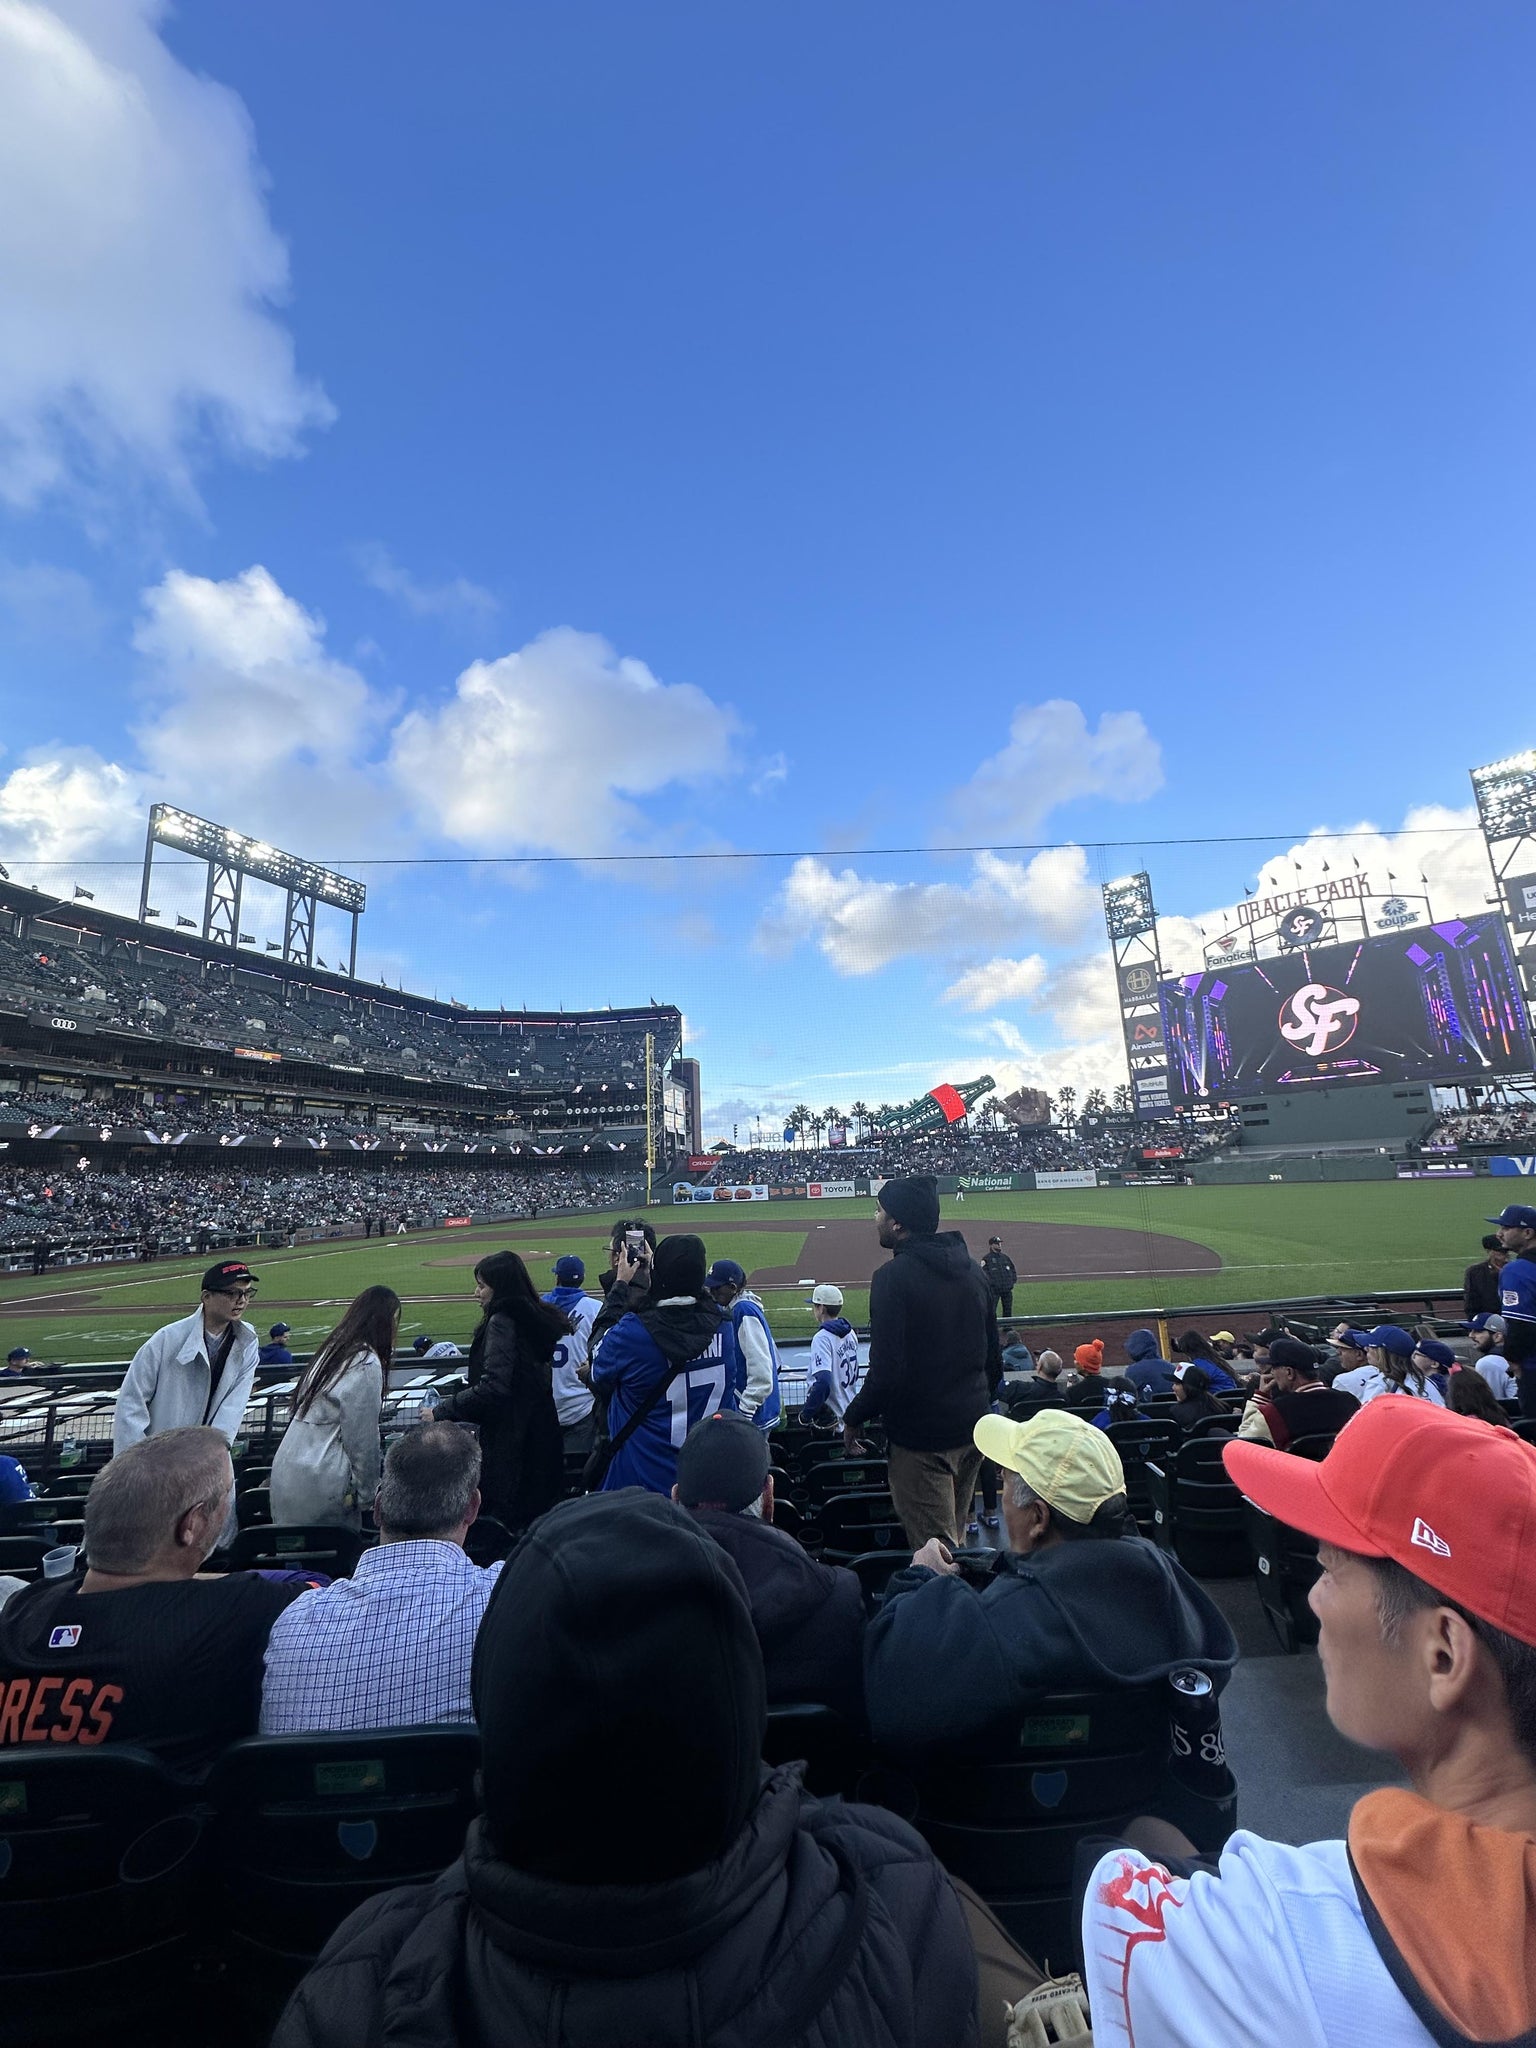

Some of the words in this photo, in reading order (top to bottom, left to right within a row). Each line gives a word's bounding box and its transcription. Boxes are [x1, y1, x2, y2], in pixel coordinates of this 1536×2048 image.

[1237, 889, 1309, 926] ORACLE
[1317, 872, 1373, 901] PARK
[1376, 912, 1419, 929] coupa
[1206, 950, 1252, 968] Fanatics
[1281, 983, 1360, 1056] SF
[970, 1176, 1012, 1187] National
[666, 1364, 726, 1448] 17
